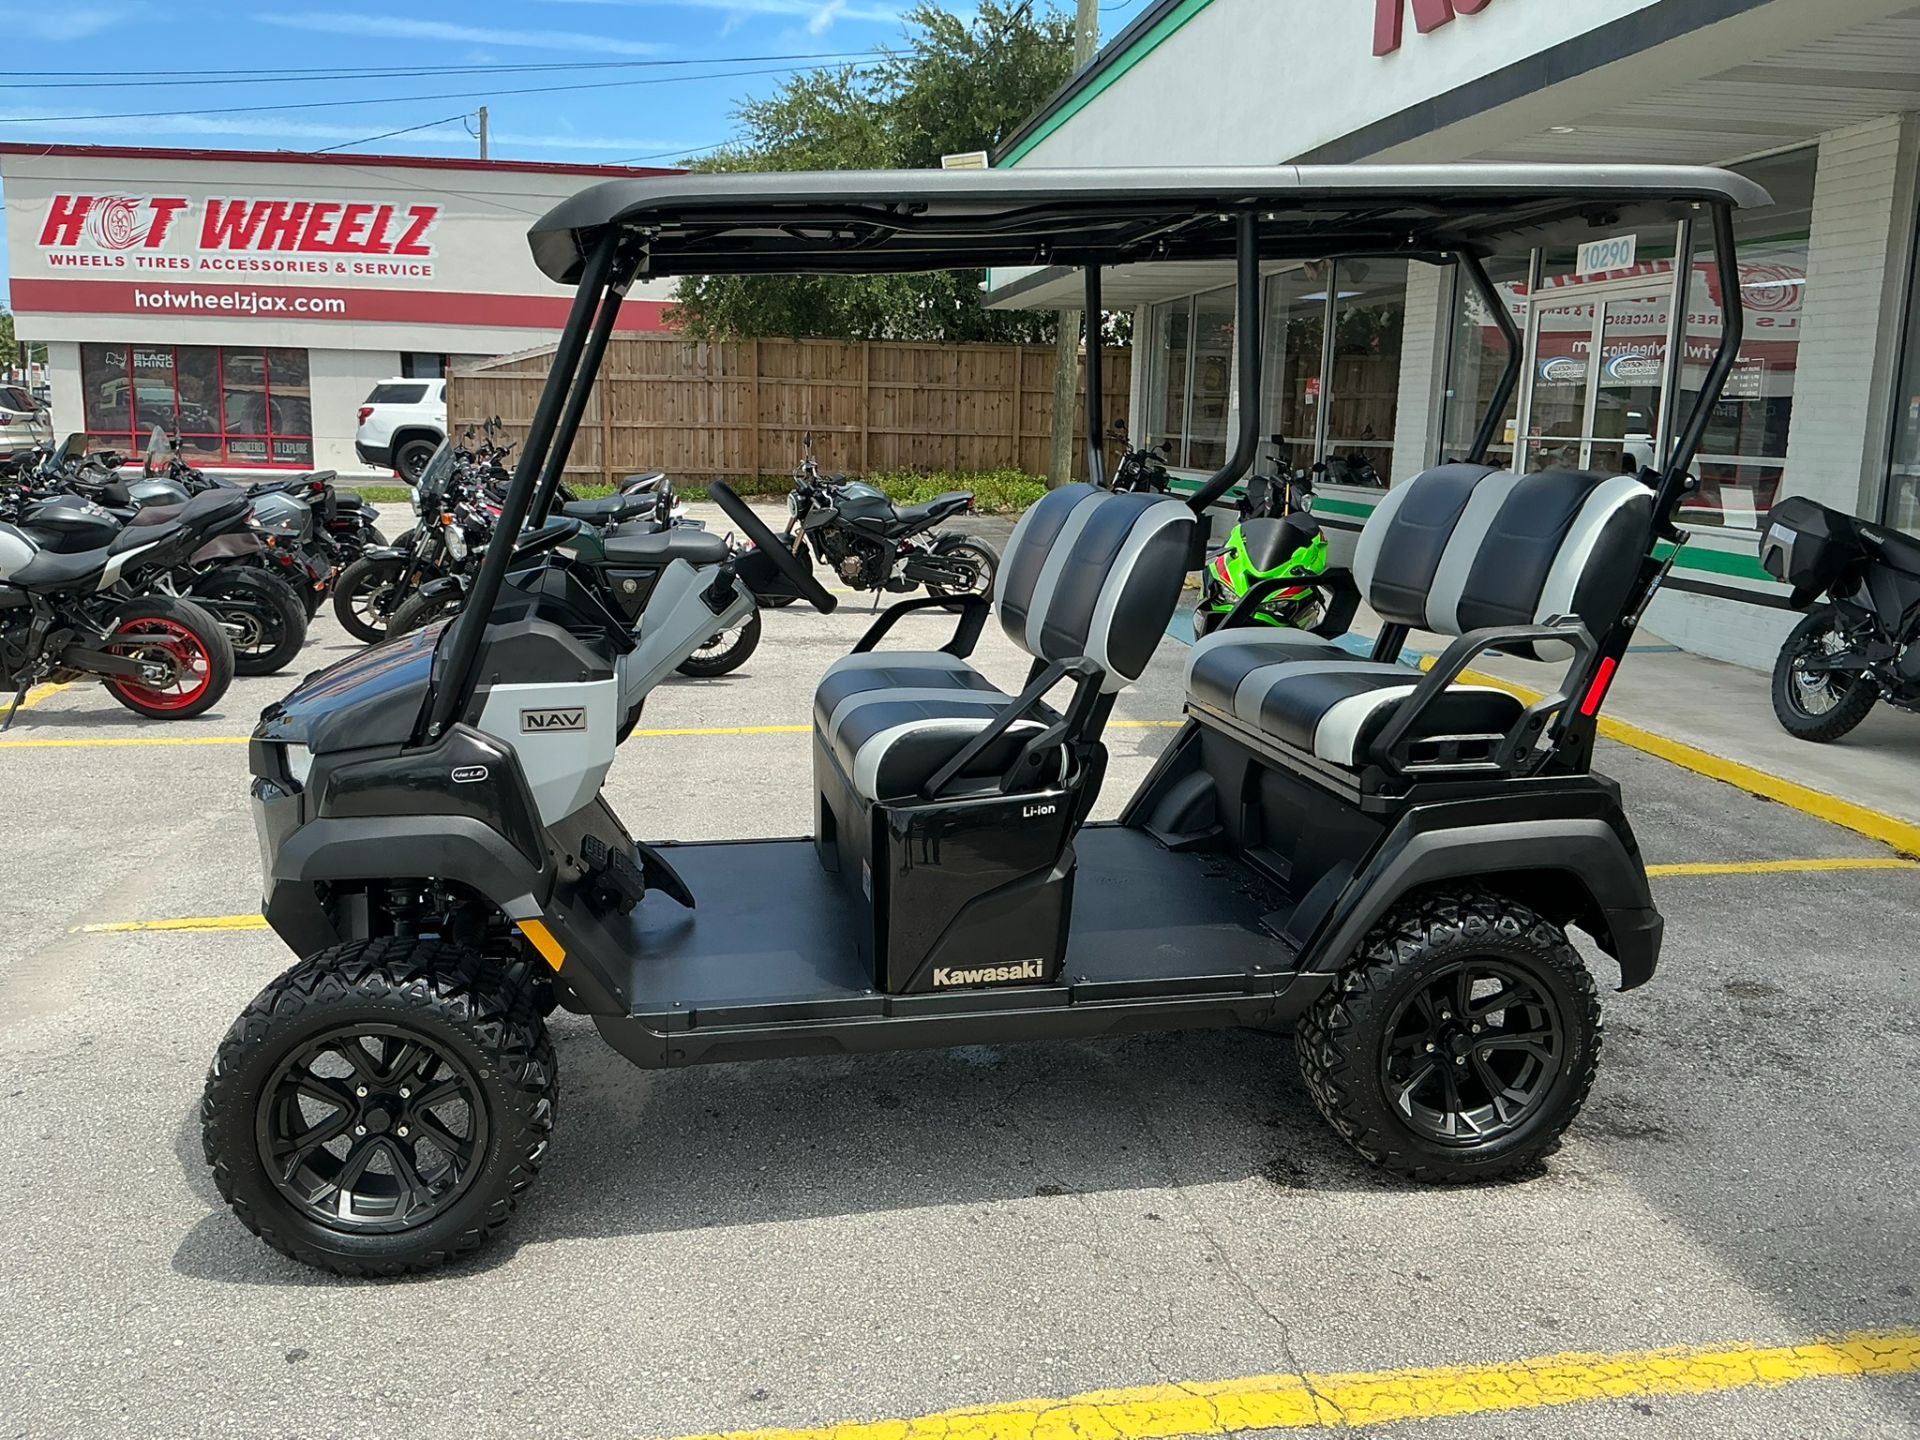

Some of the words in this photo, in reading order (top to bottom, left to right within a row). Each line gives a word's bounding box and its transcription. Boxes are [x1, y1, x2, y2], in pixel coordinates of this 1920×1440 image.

[38, 194, 188, 250] HOT
[199, 199, 440, 257] WHEELZ
[49, 254, 125, 267] WHEELS
[136, 256, 191, 269] TIRES
[200, 257, 329, 273] ACCESSORIES
[335, 262, 347, 273] &
[353, 262, 433, 277] SERVICE
[1581, 240, 1630, 271] 10290
[134, 289, 346, 314] hotwheelzjax.com
[133, 353, 173, 361] BLACK
[134, 360, 174, 368] RHINO
[525, 711, 584, 731] NAV
[1022, 802, 1056, 818] Li-ion
[933, 960, 1043, 986] Kawasaki
